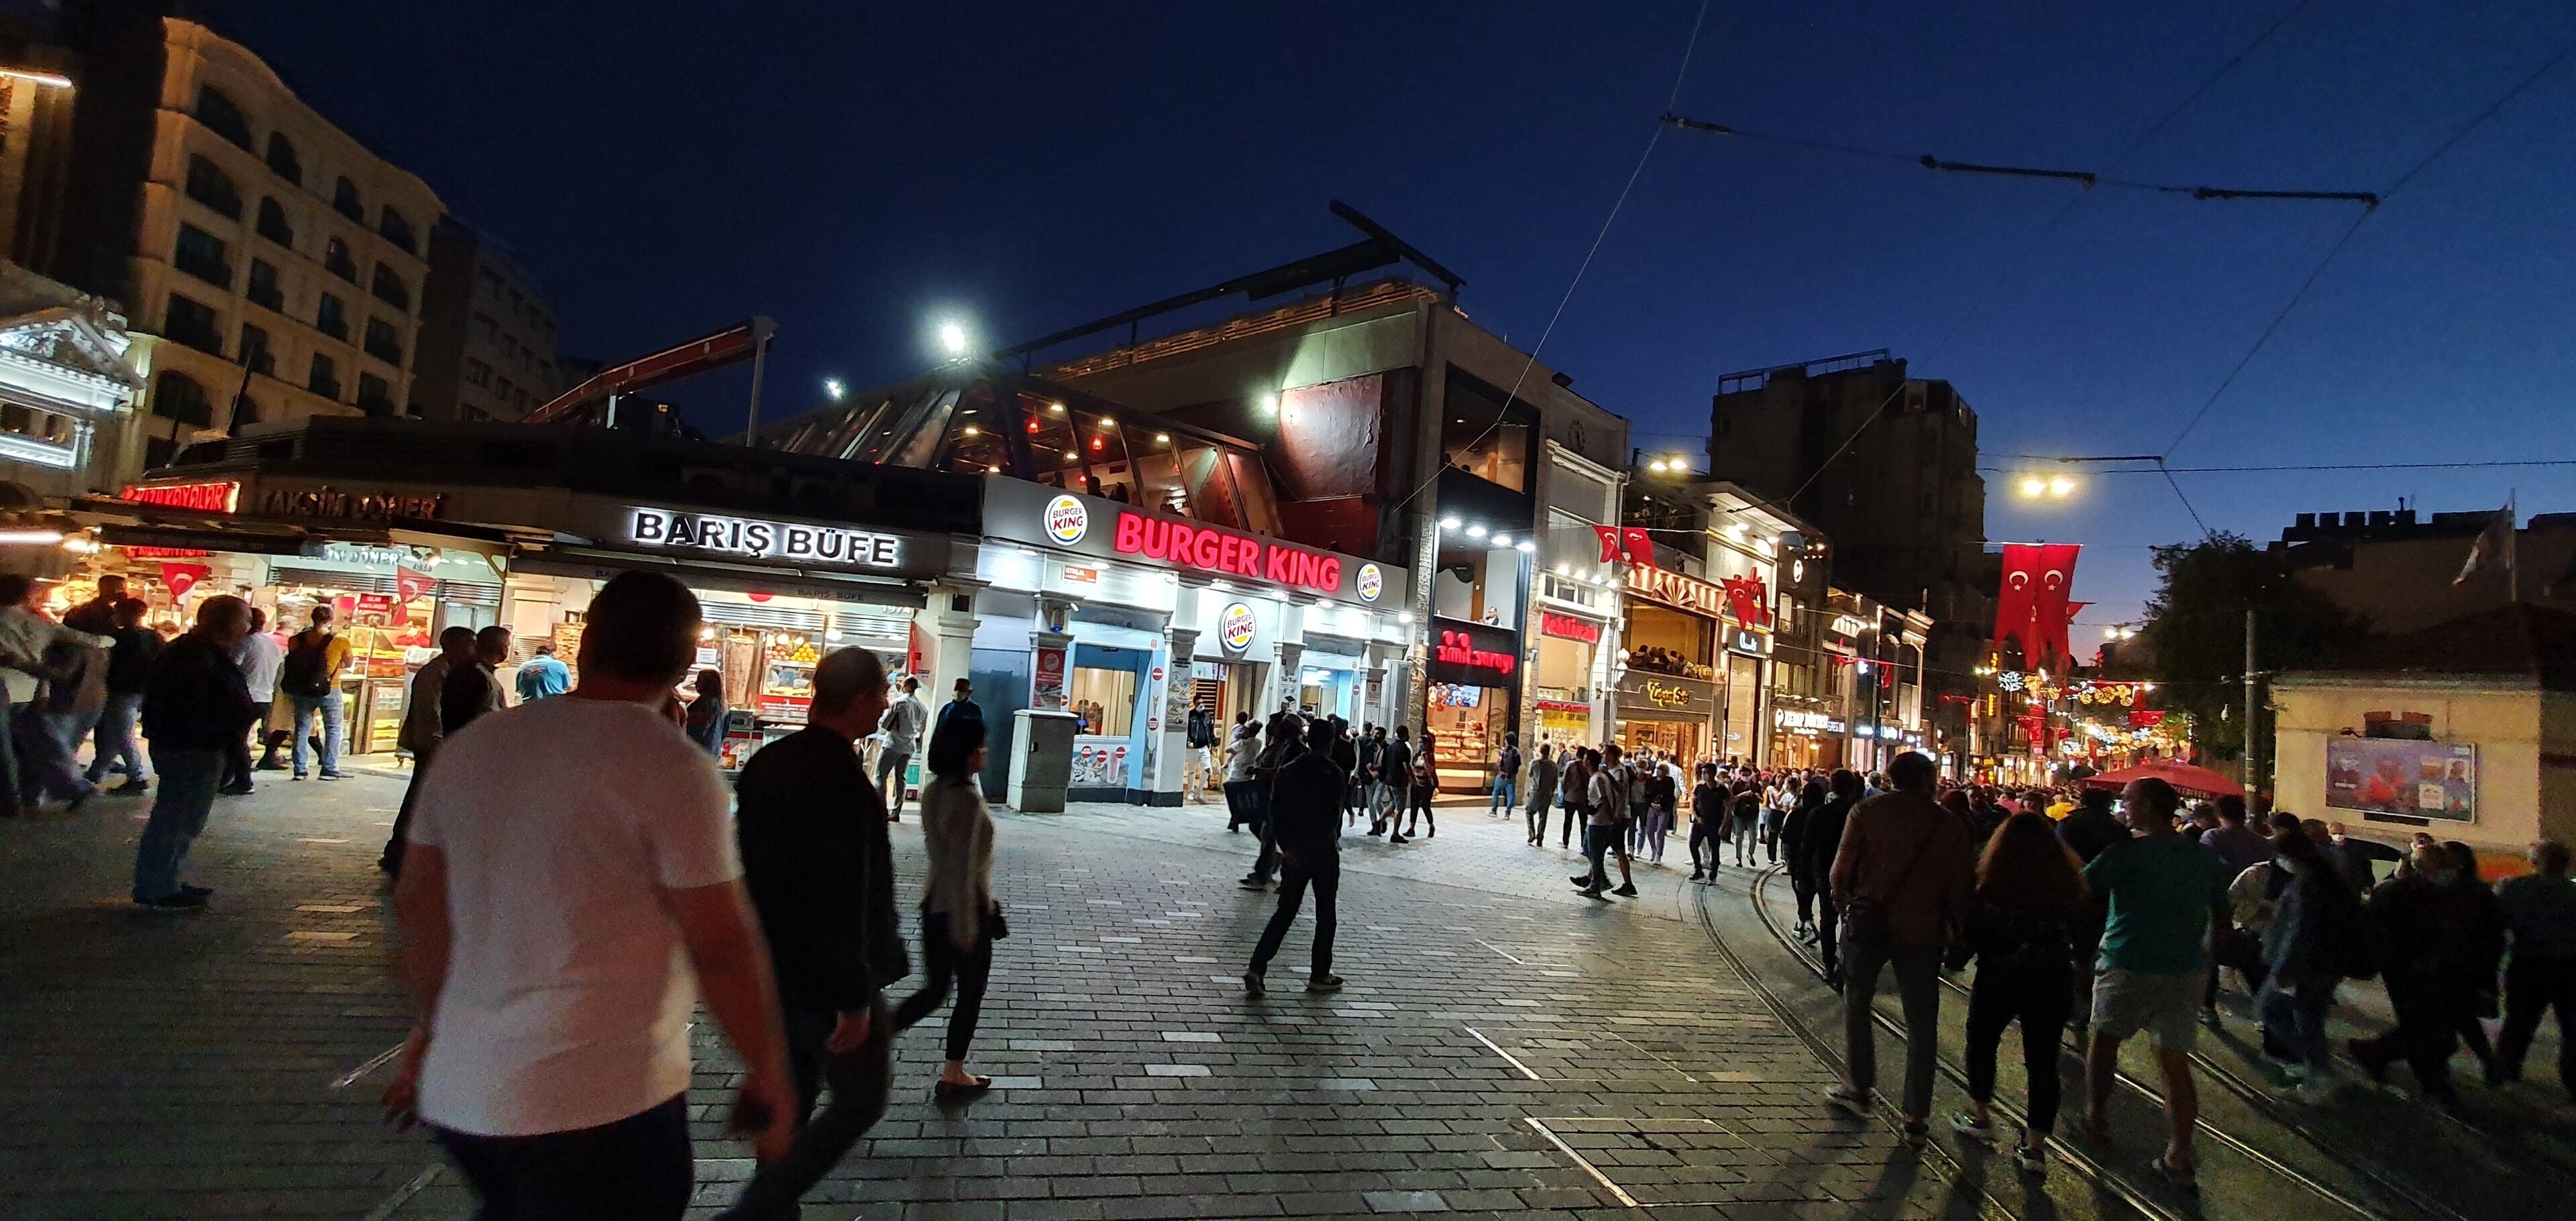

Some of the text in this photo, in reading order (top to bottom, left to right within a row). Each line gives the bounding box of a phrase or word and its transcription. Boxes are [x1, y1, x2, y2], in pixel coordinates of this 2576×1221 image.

[1053, 508, 1082, 519] BURGER
[1053, 516, 1083, 531] KING
[635, 512, 896, 564] BARIŞ BÜFE
[1114, 511, 1340, 592] BURGER KING
[1362, 580, 1379, 590] KING
[1228, 614, 1252, 628] BURGER
[1228, 621, 1252, 639] KING
